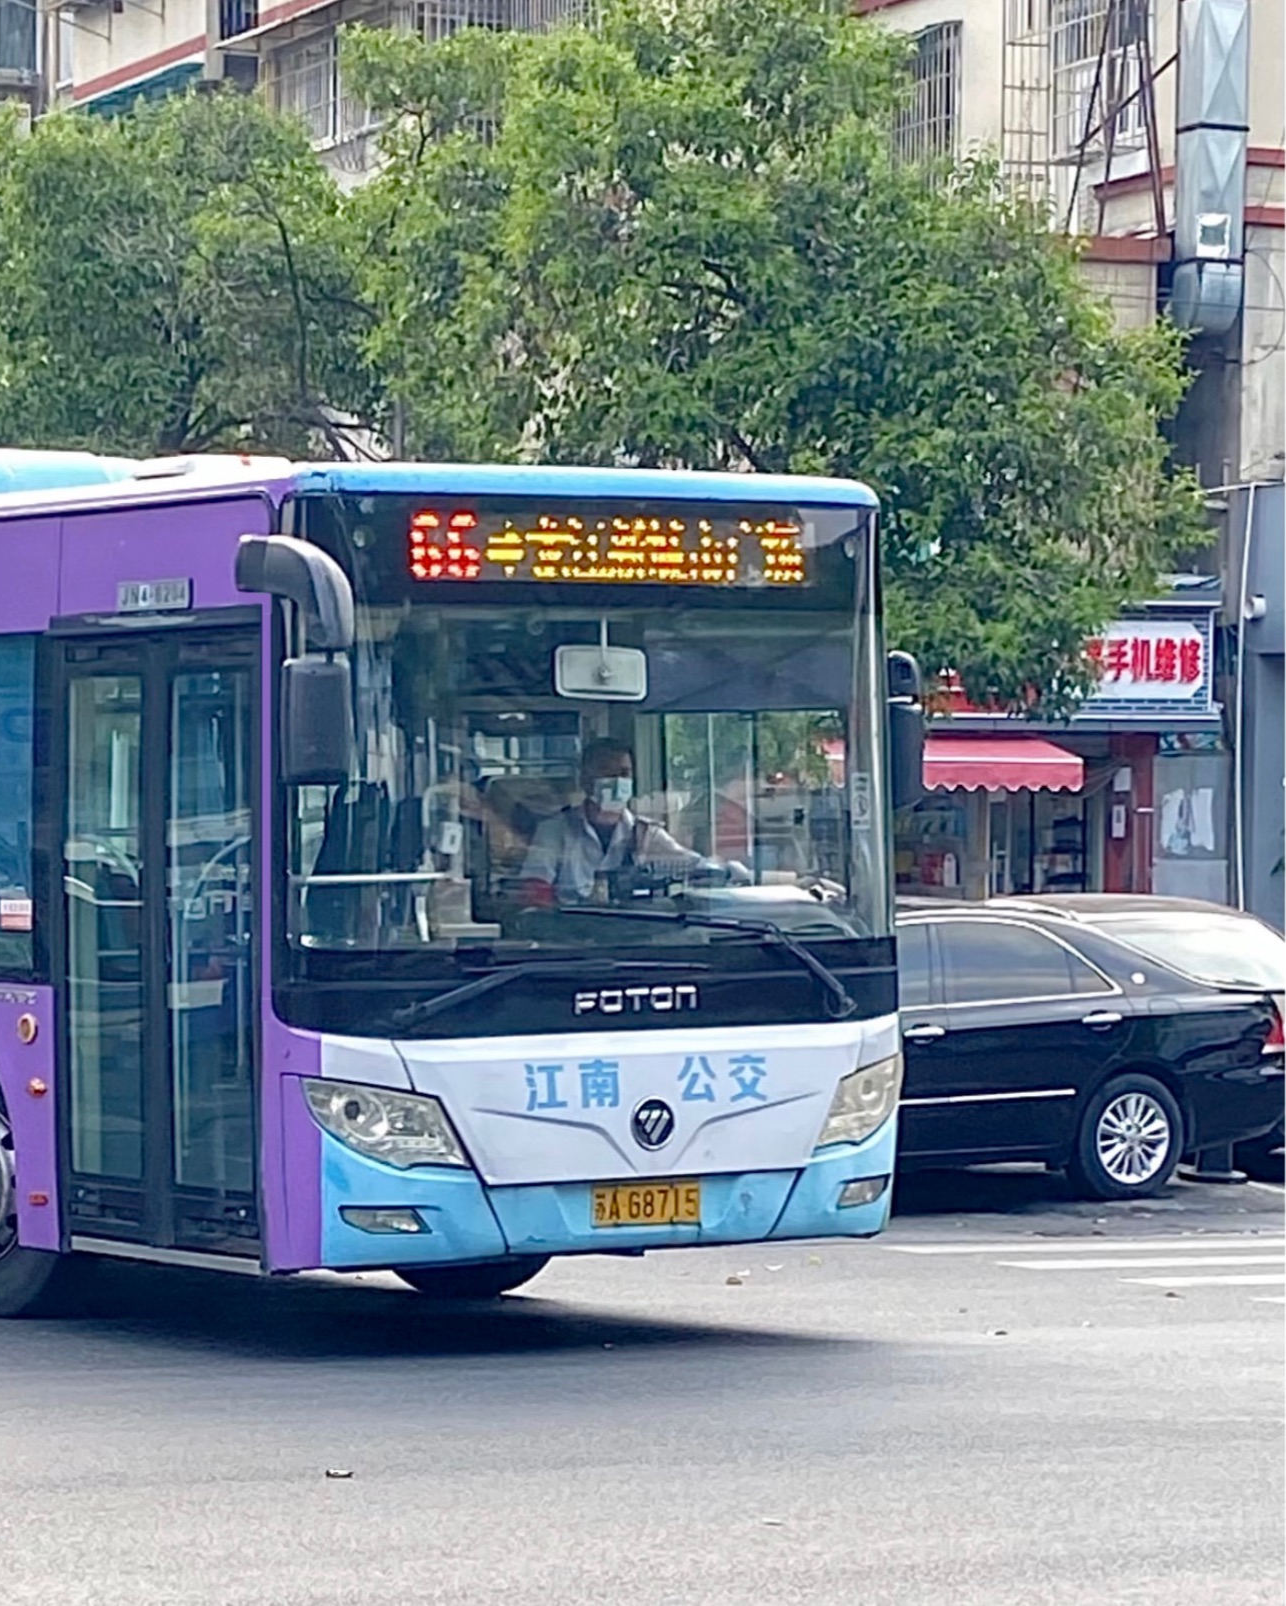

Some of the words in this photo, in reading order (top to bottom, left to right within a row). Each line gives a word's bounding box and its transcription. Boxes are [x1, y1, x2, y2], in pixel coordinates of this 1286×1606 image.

[411, 511, 480, 579] 66
[575, 985, 697, 1014] FOTON
[524, 1058, 620, 1112] 江南
[677, 1054, 768, 1104] 公交
